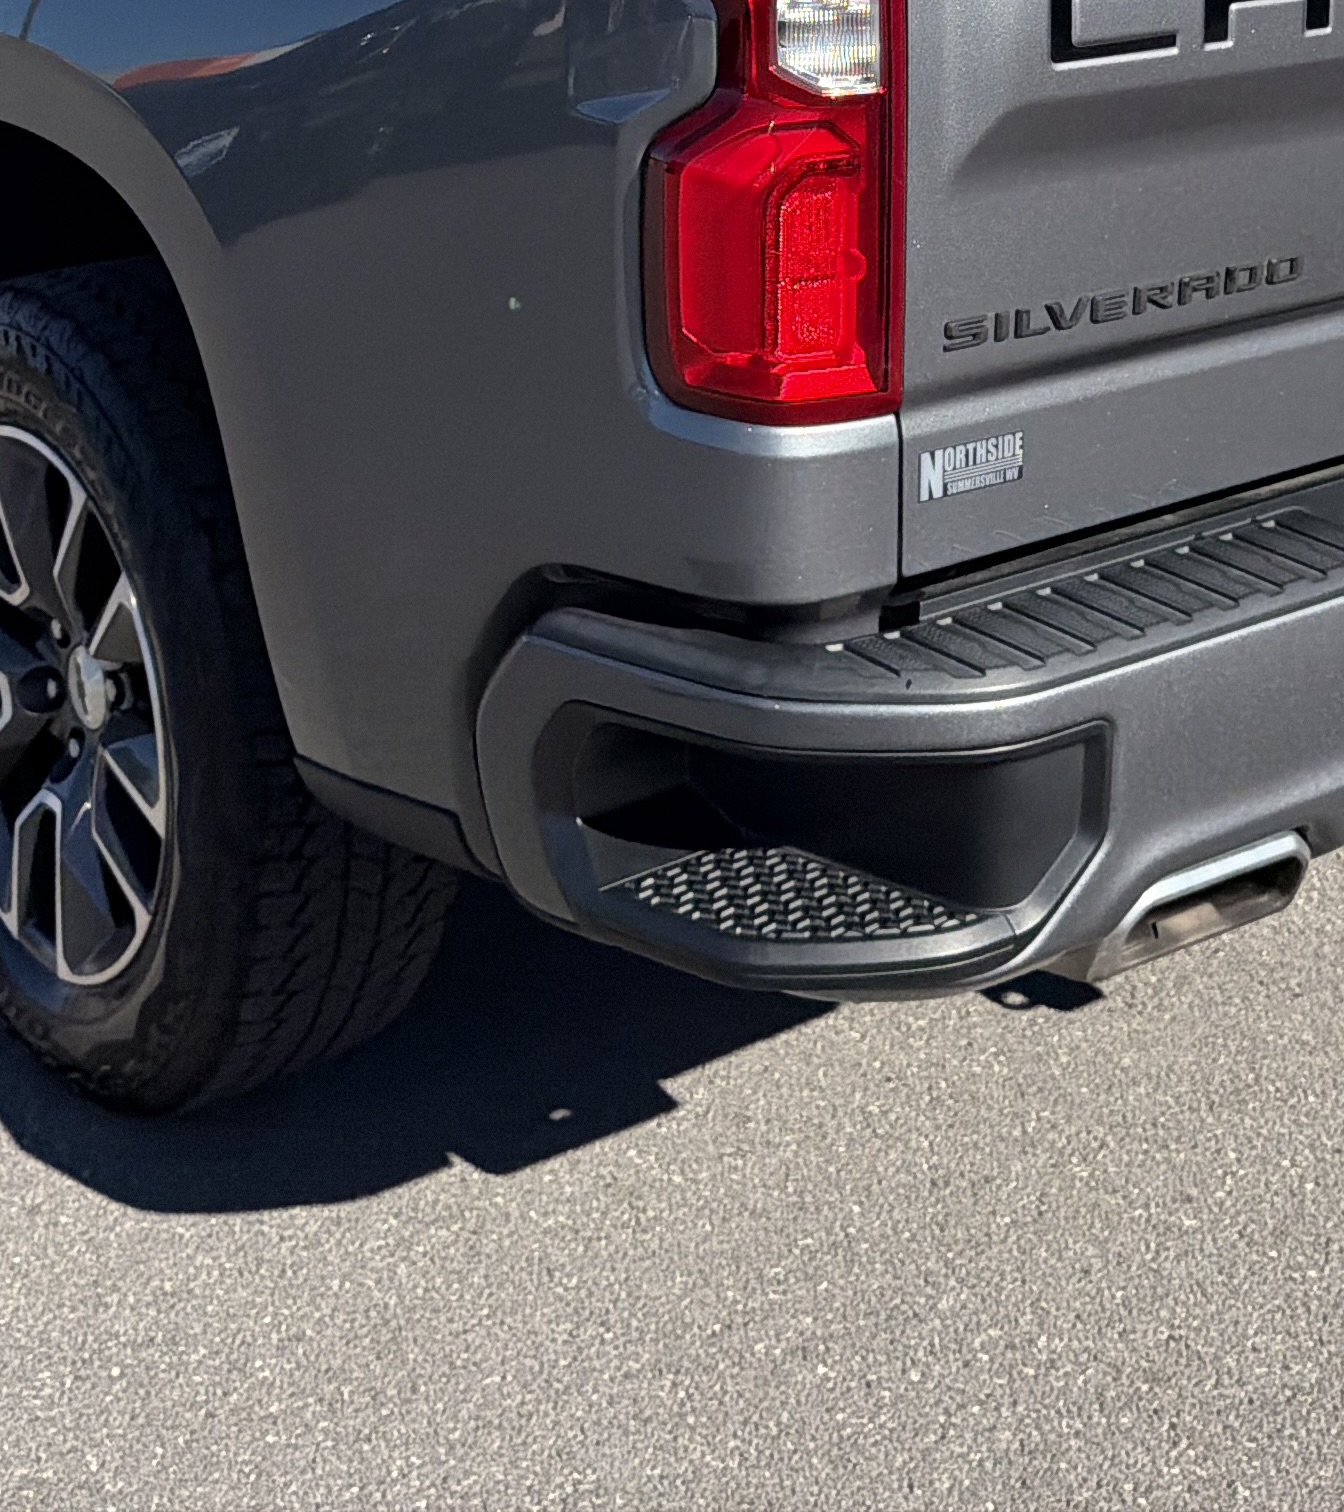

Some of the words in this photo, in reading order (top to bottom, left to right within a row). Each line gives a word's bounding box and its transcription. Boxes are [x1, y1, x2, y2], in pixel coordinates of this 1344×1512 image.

[942, 256, 1305, 353] SILVERADO
[920, 431, 1024, 503] NORTHSIDE
[946, 470, 1005, 496] SUMMERSVILLE
[1005, 466, 1020, 481] WV
